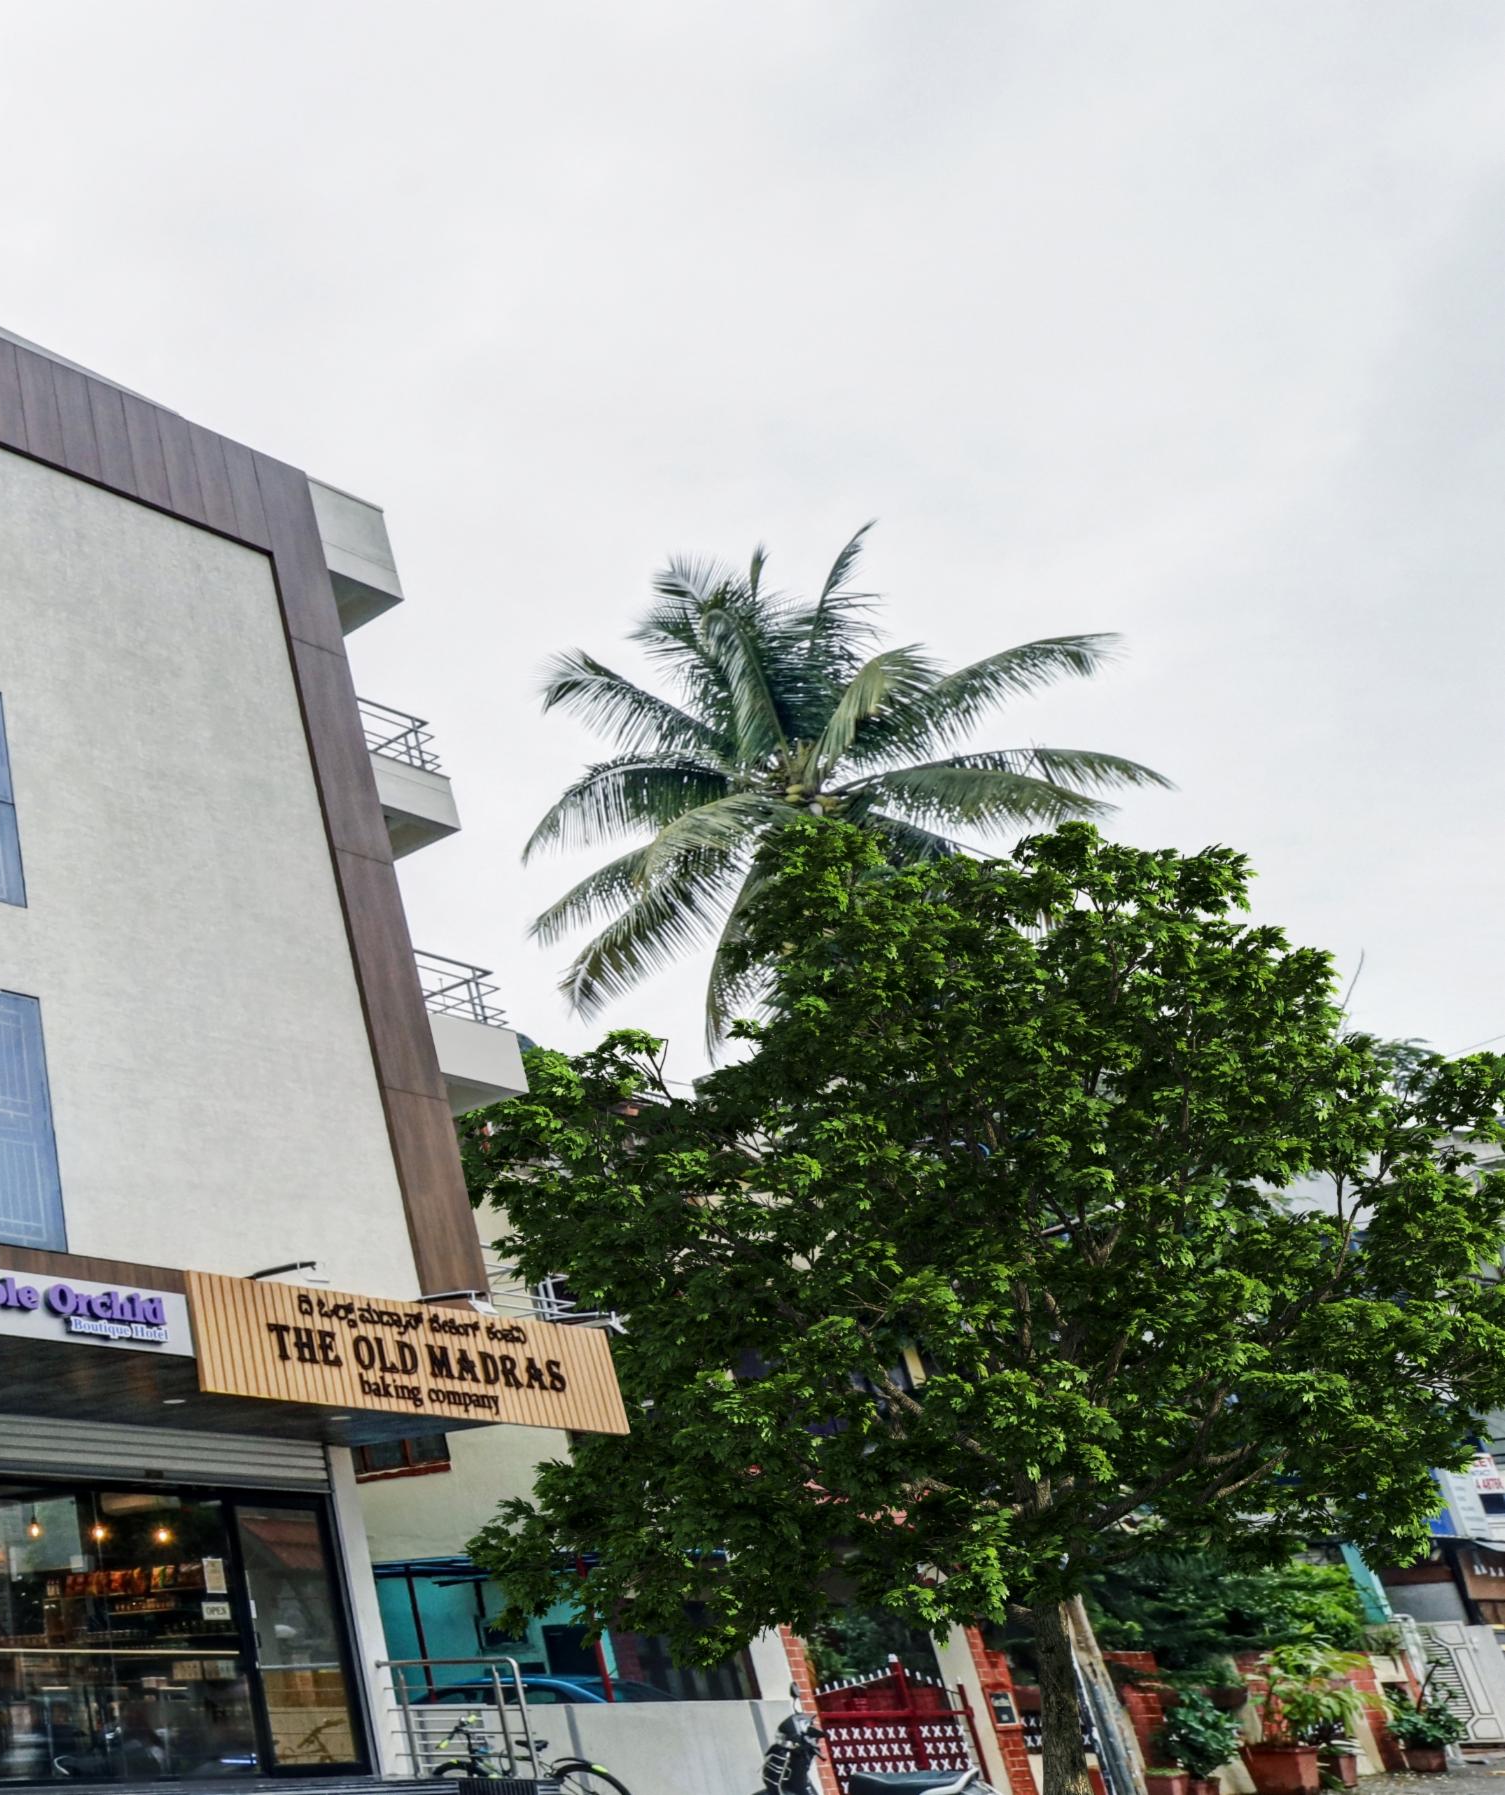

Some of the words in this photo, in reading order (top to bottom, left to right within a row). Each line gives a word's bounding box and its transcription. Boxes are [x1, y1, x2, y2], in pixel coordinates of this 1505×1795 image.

[46, 1284, 166, 1325] Orchid
[297, 1294, 314, 1316] ದಿ
[71, 1318, 132, 1338] Boutique
[131, 1324, 168, 1341] Hotel
[267, 1324, 343, 1367] THE
[353, 1335, 418, 1375] OLD
[425, 1343, 567, 1392] MADRAS
[359, 1373, 422, 1406] baking
[428, 1387, 499, 1415] company
[206, 1606, 227, 1616] OPEN
